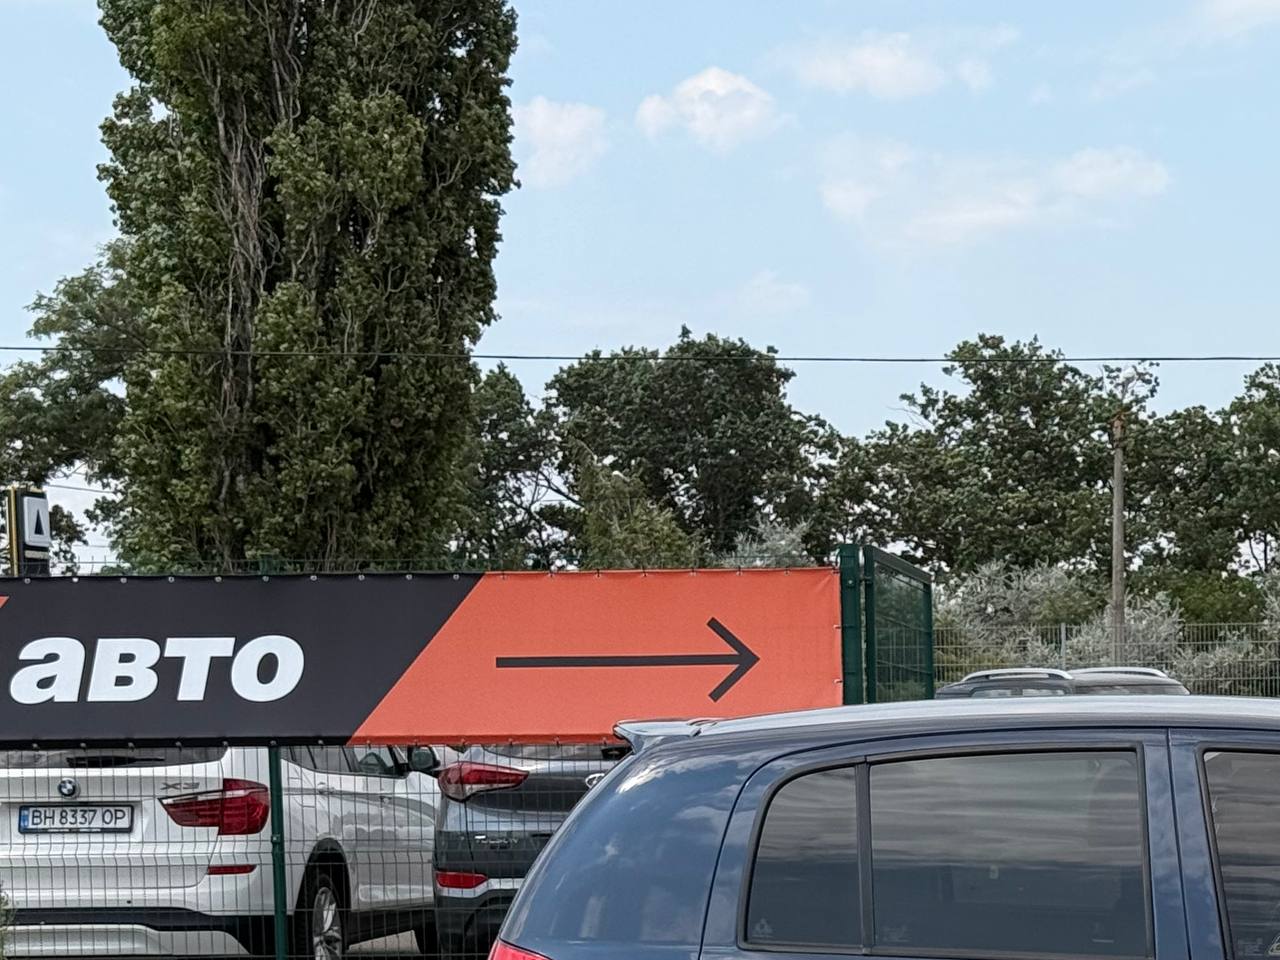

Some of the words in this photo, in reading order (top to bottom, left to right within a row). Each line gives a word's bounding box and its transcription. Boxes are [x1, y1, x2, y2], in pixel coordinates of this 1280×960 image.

[9, 634, 305, 705] авто
[31, 809, 56, 826] BH
[59, 809, 98, 826] 8337
[102, 808, 127, 826] OP
